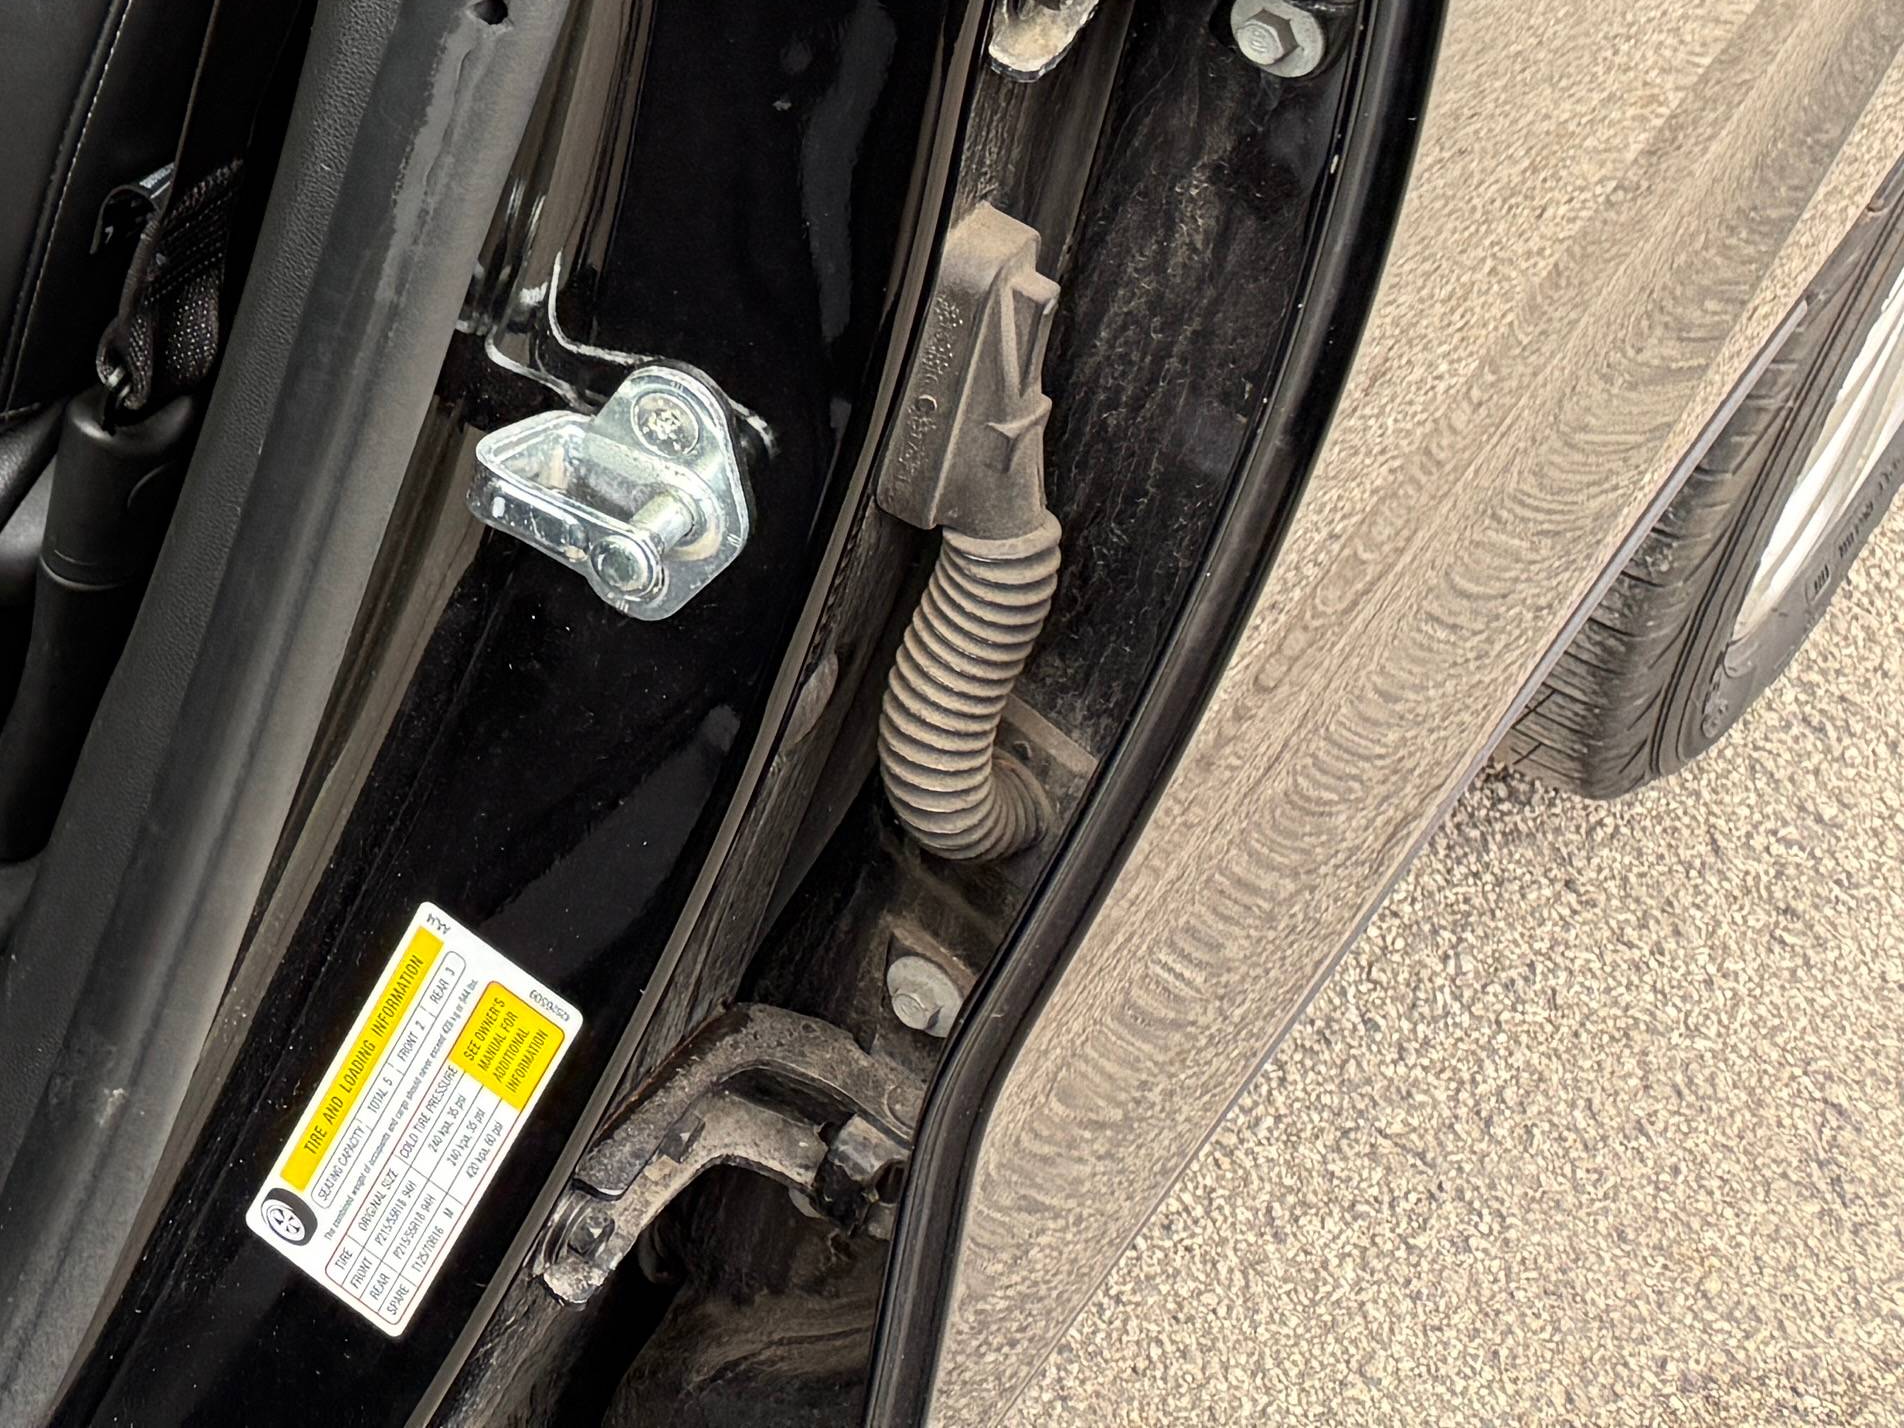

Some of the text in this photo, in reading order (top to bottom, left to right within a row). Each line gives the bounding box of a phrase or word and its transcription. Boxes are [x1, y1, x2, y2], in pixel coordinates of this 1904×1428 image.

[428, 965, 456, 1005] REAR 3
[396, 1019, 426, 1062] FRONT 2
[462, 995, 506, 1062] SEE OWNER'S
[476, 1009, 519, 1072] MANUAL FOR
[302, 952, 424, 1157] TIRE AND LOADING INFORMATION
[490, 1024, 530, 1083] ADDITIONAL
[504, 1027, 549, 1094] INFORMATION
[366, 1074, 394, 1115] TOTAL 5
[398, 1063, 458, 1160] COLD TIRE PRESSURE
[451, 1091, 469, 1110] psi
[471, 1105, 487, 1124] psi
[323, 1225, 336, 1241] The
[330, 1193, 354, 1229] combined
[349, 1171, 368, 1198] weight
[366, 1130, 392, 1167] occupants
[385, 1116, 399, 1133] and
[394, 1098, 411, 1121] cargo
[403, 1075, 422, 1101] should
[417, 1056, 433, 1079] never
[427, 1032, 447, 1059] exceed
[489, 1119, 505, 1137] psi
[317, 1124, 366, 1202] SEATING CAPACITY
[356, 1166, 399, 1233] ORIGINAL SIZE
[334, 1246, 353, 1271] TIRE
[349, 1255, 373, 1290] FRONT
[368, 1271, 390, 1301] REAR
[385, 1282, 410, 1316] SPARE
